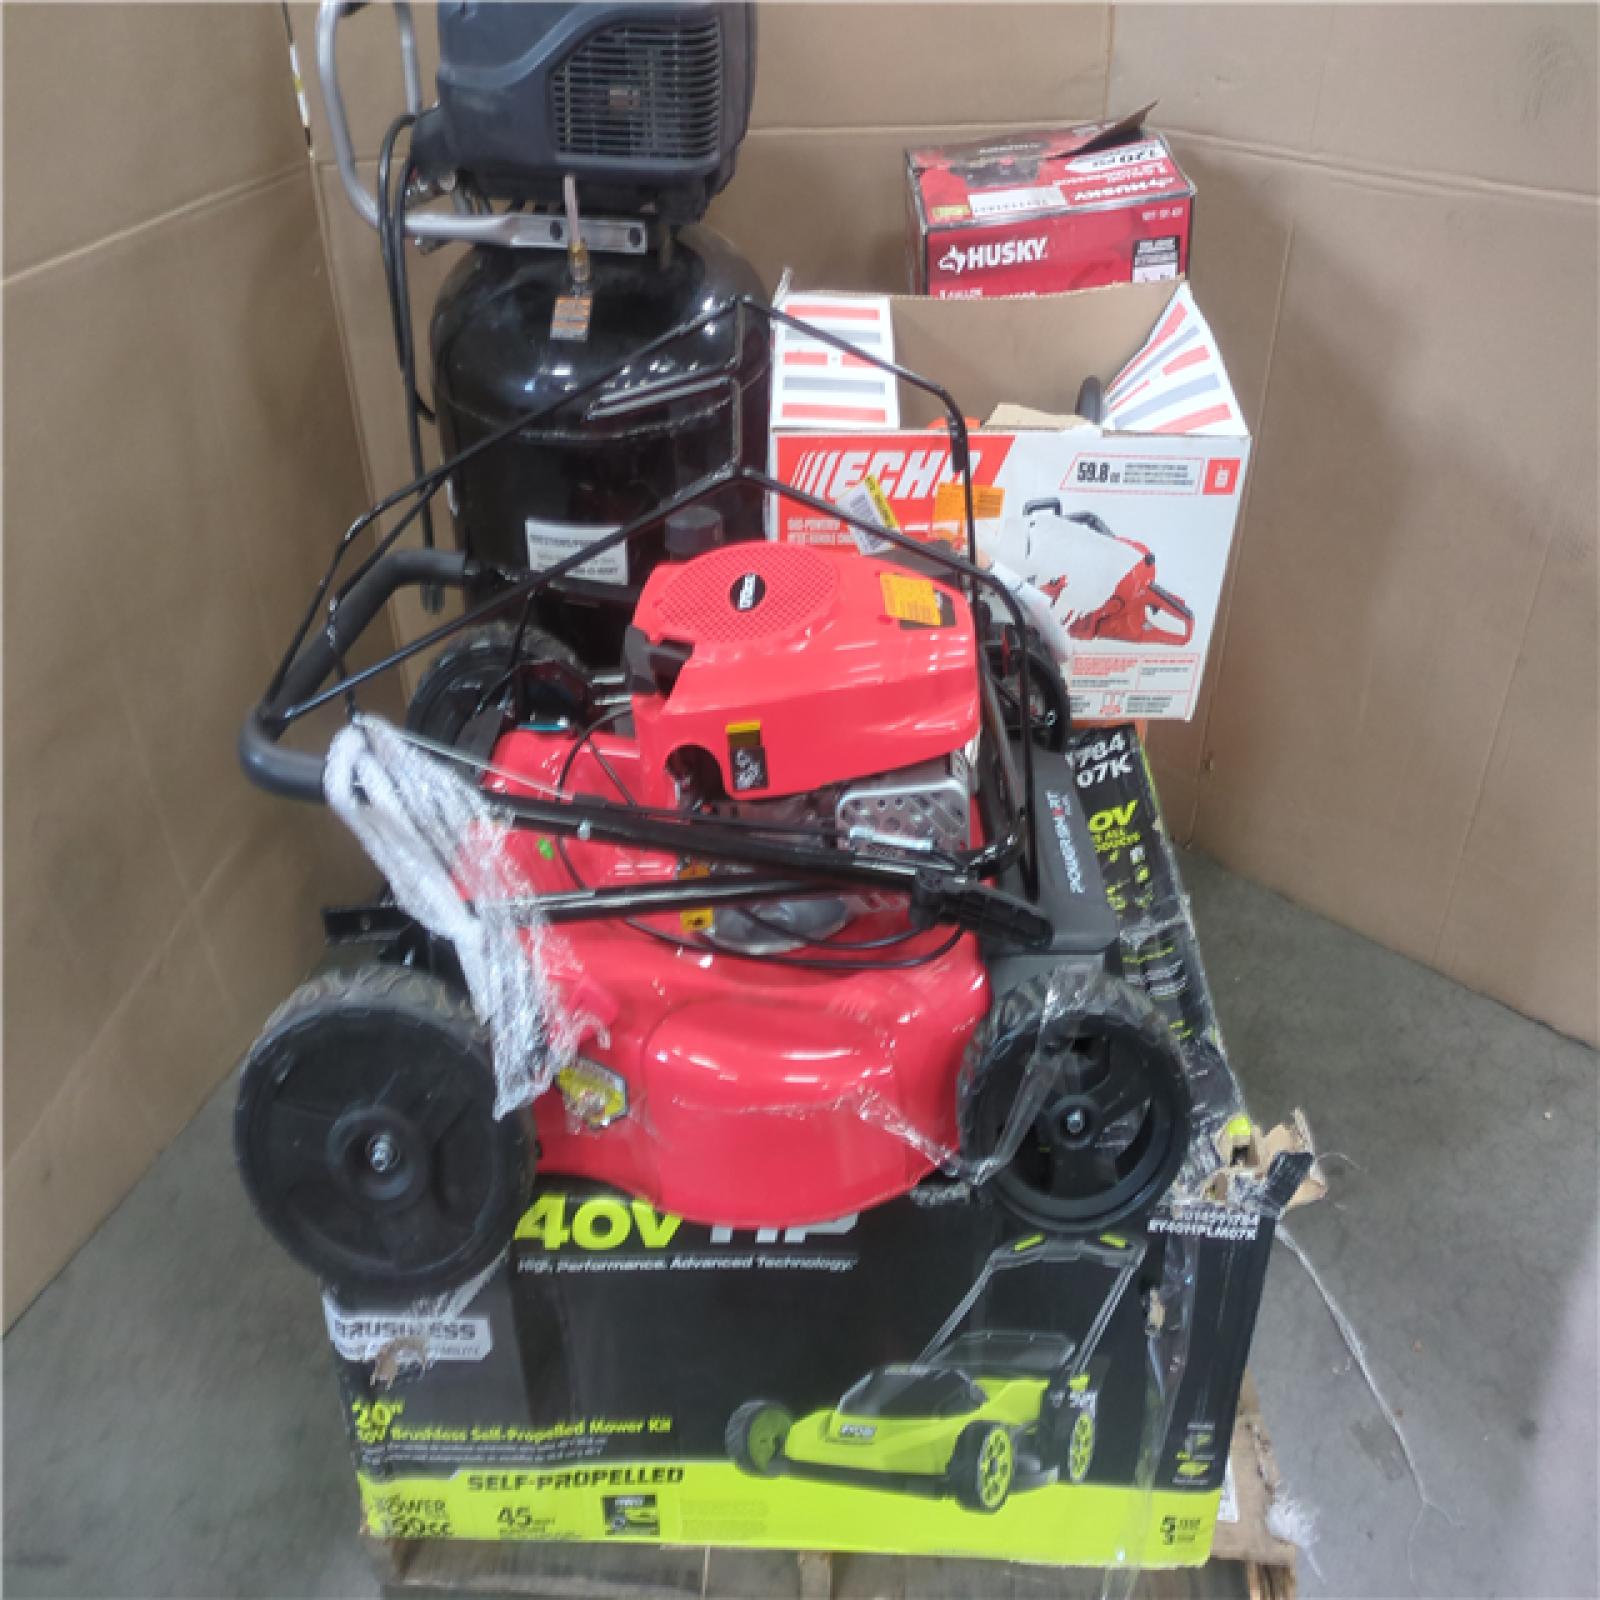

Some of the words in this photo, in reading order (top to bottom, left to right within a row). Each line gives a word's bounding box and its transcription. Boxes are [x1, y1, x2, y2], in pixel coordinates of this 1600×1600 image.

[967, 237, 1047, 268] HUSKY
[1077, 461, 1110, 483] 59.8
[514, 1193, 683, 1250] 40V
[589, 1414, 644, 1434] Mower
[466, 1467, 685, 1491] SELF-PROPELLED
